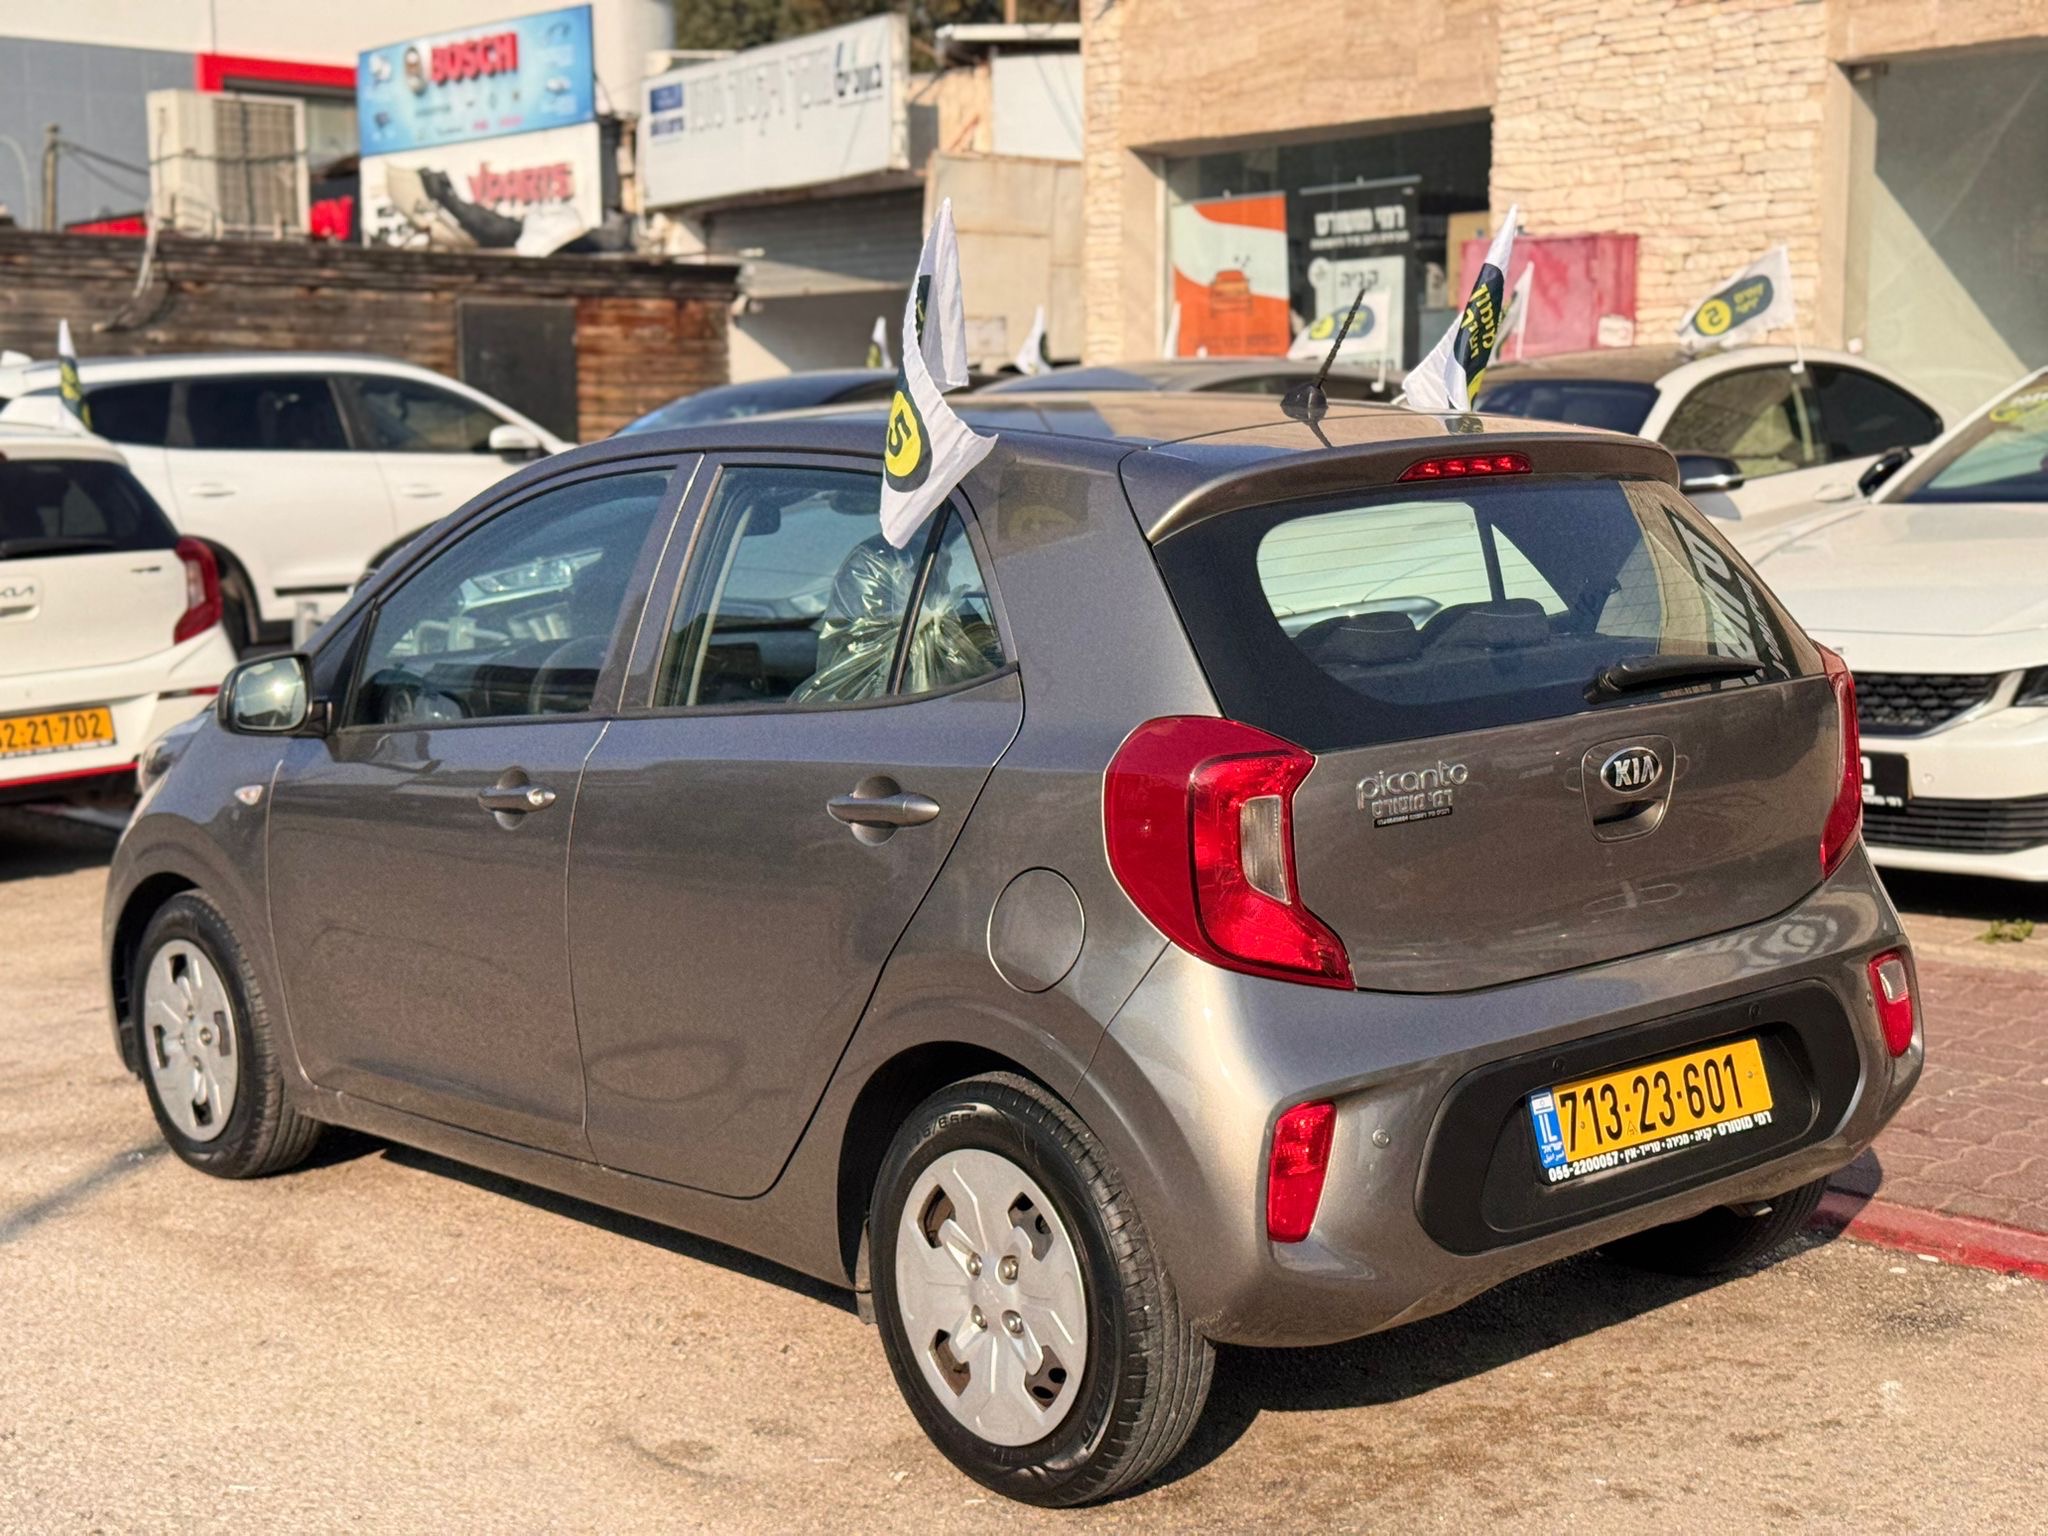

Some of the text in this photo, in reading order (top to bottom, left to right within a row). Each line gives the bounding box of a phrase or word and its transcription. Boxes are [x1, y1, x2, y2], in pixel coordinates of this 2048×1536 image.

[431, 31, 517, 85] BOSCH
[1469, 283, 1496, 350] מימון
[888, 409, 912, 458] 5
[1356, 760, 1469, 810] picanto
[1614, 755, 1655, 787] KIA
[1428, 789, 1453, 808] רמי
[1538, 1113, 1558, 1144] IL
[1717, 1117, 1753, 1137] מוטורס
[1754, 1111, 1773, 1126] רמי
[1548, 1150, 1620, 1183] 055-2200057
